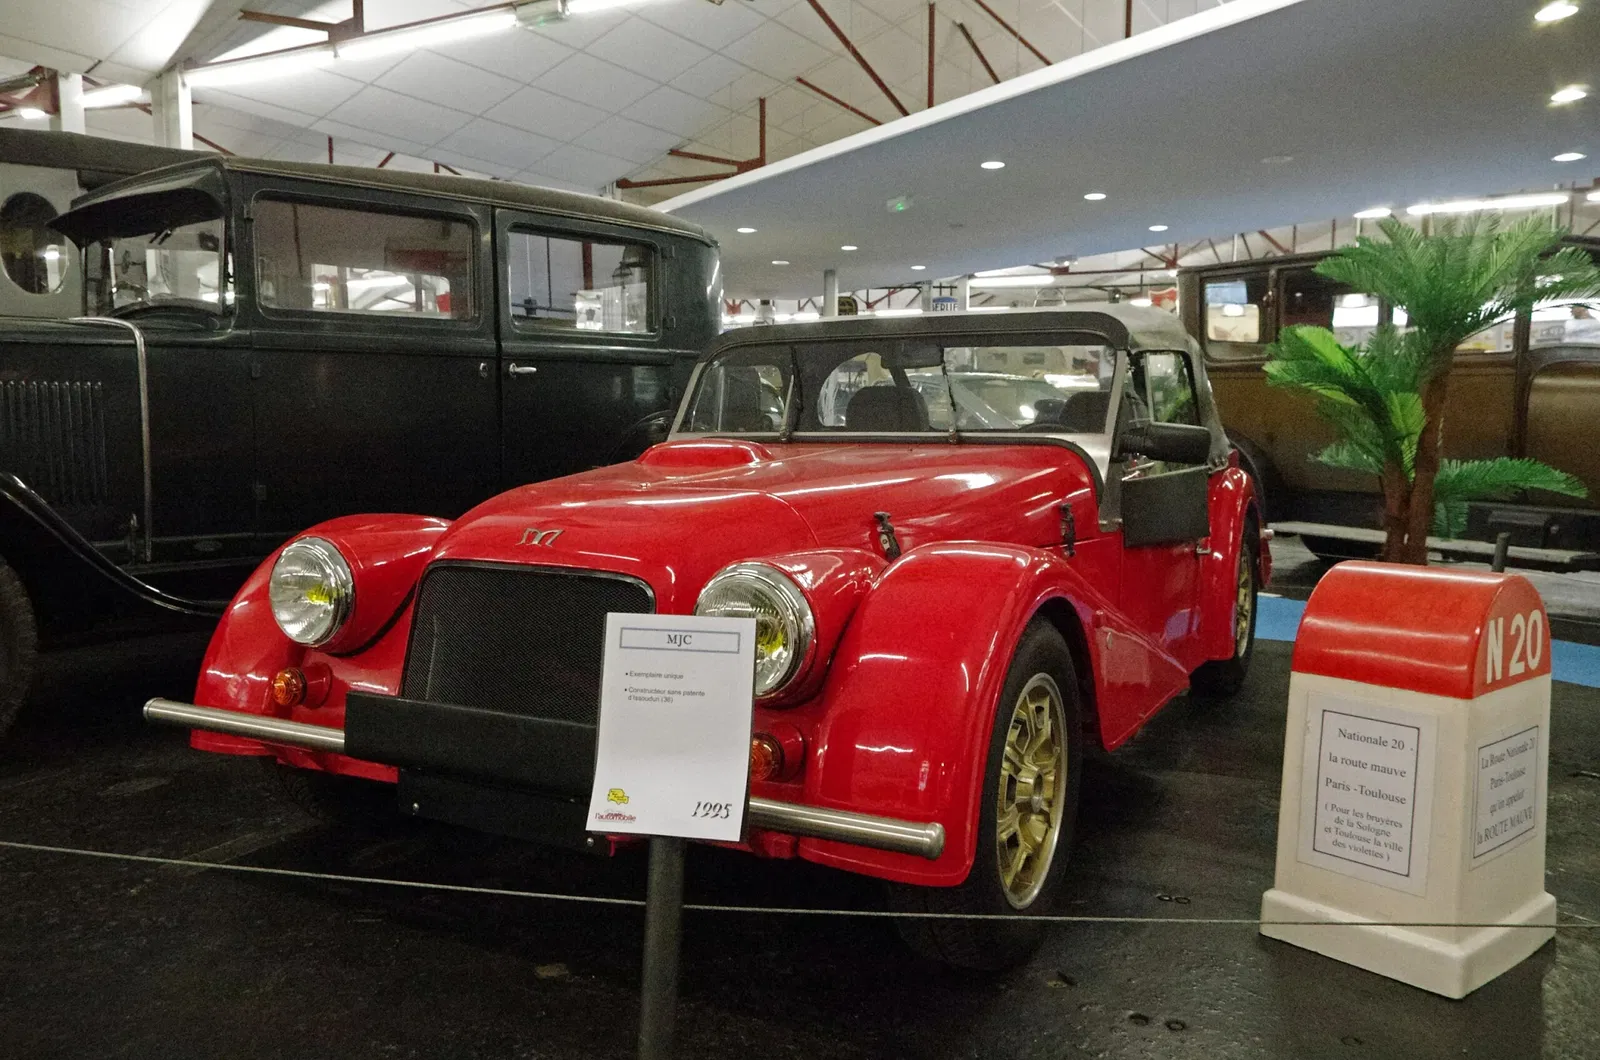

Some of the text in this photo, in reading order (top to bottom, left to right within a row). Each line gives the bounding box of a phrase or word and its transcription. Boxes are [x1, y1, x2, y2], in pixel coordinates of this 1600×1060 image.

[667, 634, 692, 647] MJC
[1487, 610, 1542, 684] N 20
[629, 671, 684, 680] Exemplaire unique
[628, 687, 666, 695] Constructeur
[1337, 728, 1405, 750] Nationale 20
[1329, 752, 1407, 778] la route mauve
[1325, 777, 1351, 792] Paris
[691, 801, 733, 819] 1995
[1330, 803, 1350, 815] Pour
[1352, 808, 1364, 819] les
[1334, 816, 1391, 838] de la Sologne
[1484, 818, 1509, 842] ROUTE
[1510, 806, 1533, 829] MAUVE
[1332, 839, 1346, 849] des
[1348, 843, 1384, 860] violettes
[1335, 827, 1371, 844] Toulouse
[1374, 838, 1381, 847] la
[1384, 840, 1403, 852] ville
